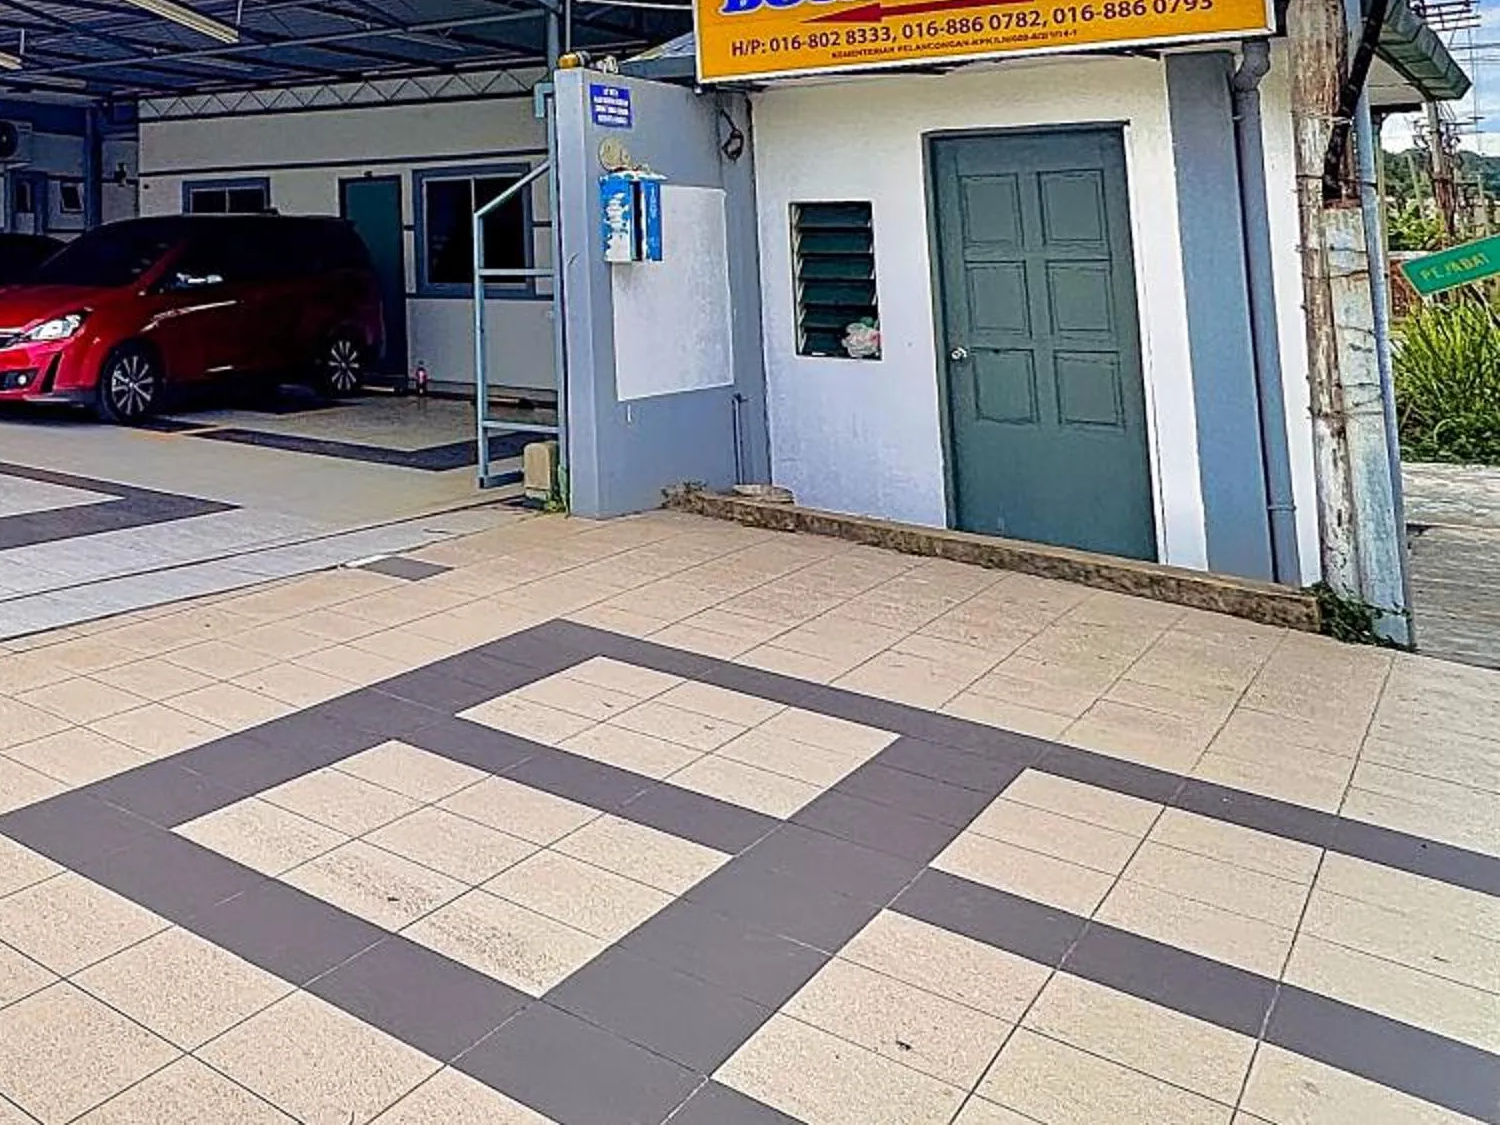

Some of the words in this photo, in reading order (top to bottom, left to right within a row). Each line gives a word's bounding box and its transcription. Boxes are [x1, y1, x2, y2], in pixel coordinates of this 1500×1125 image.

[731, 39, 766, 56] H/P:
[769, 31, 841, 52] 016-802
[845, 26, 897, 44] 8333,
[902, 16, 985, 39] 016-886
[988, 10, 1048, 30] 0782,
[1052, 0, 1147, 24] 016-886
